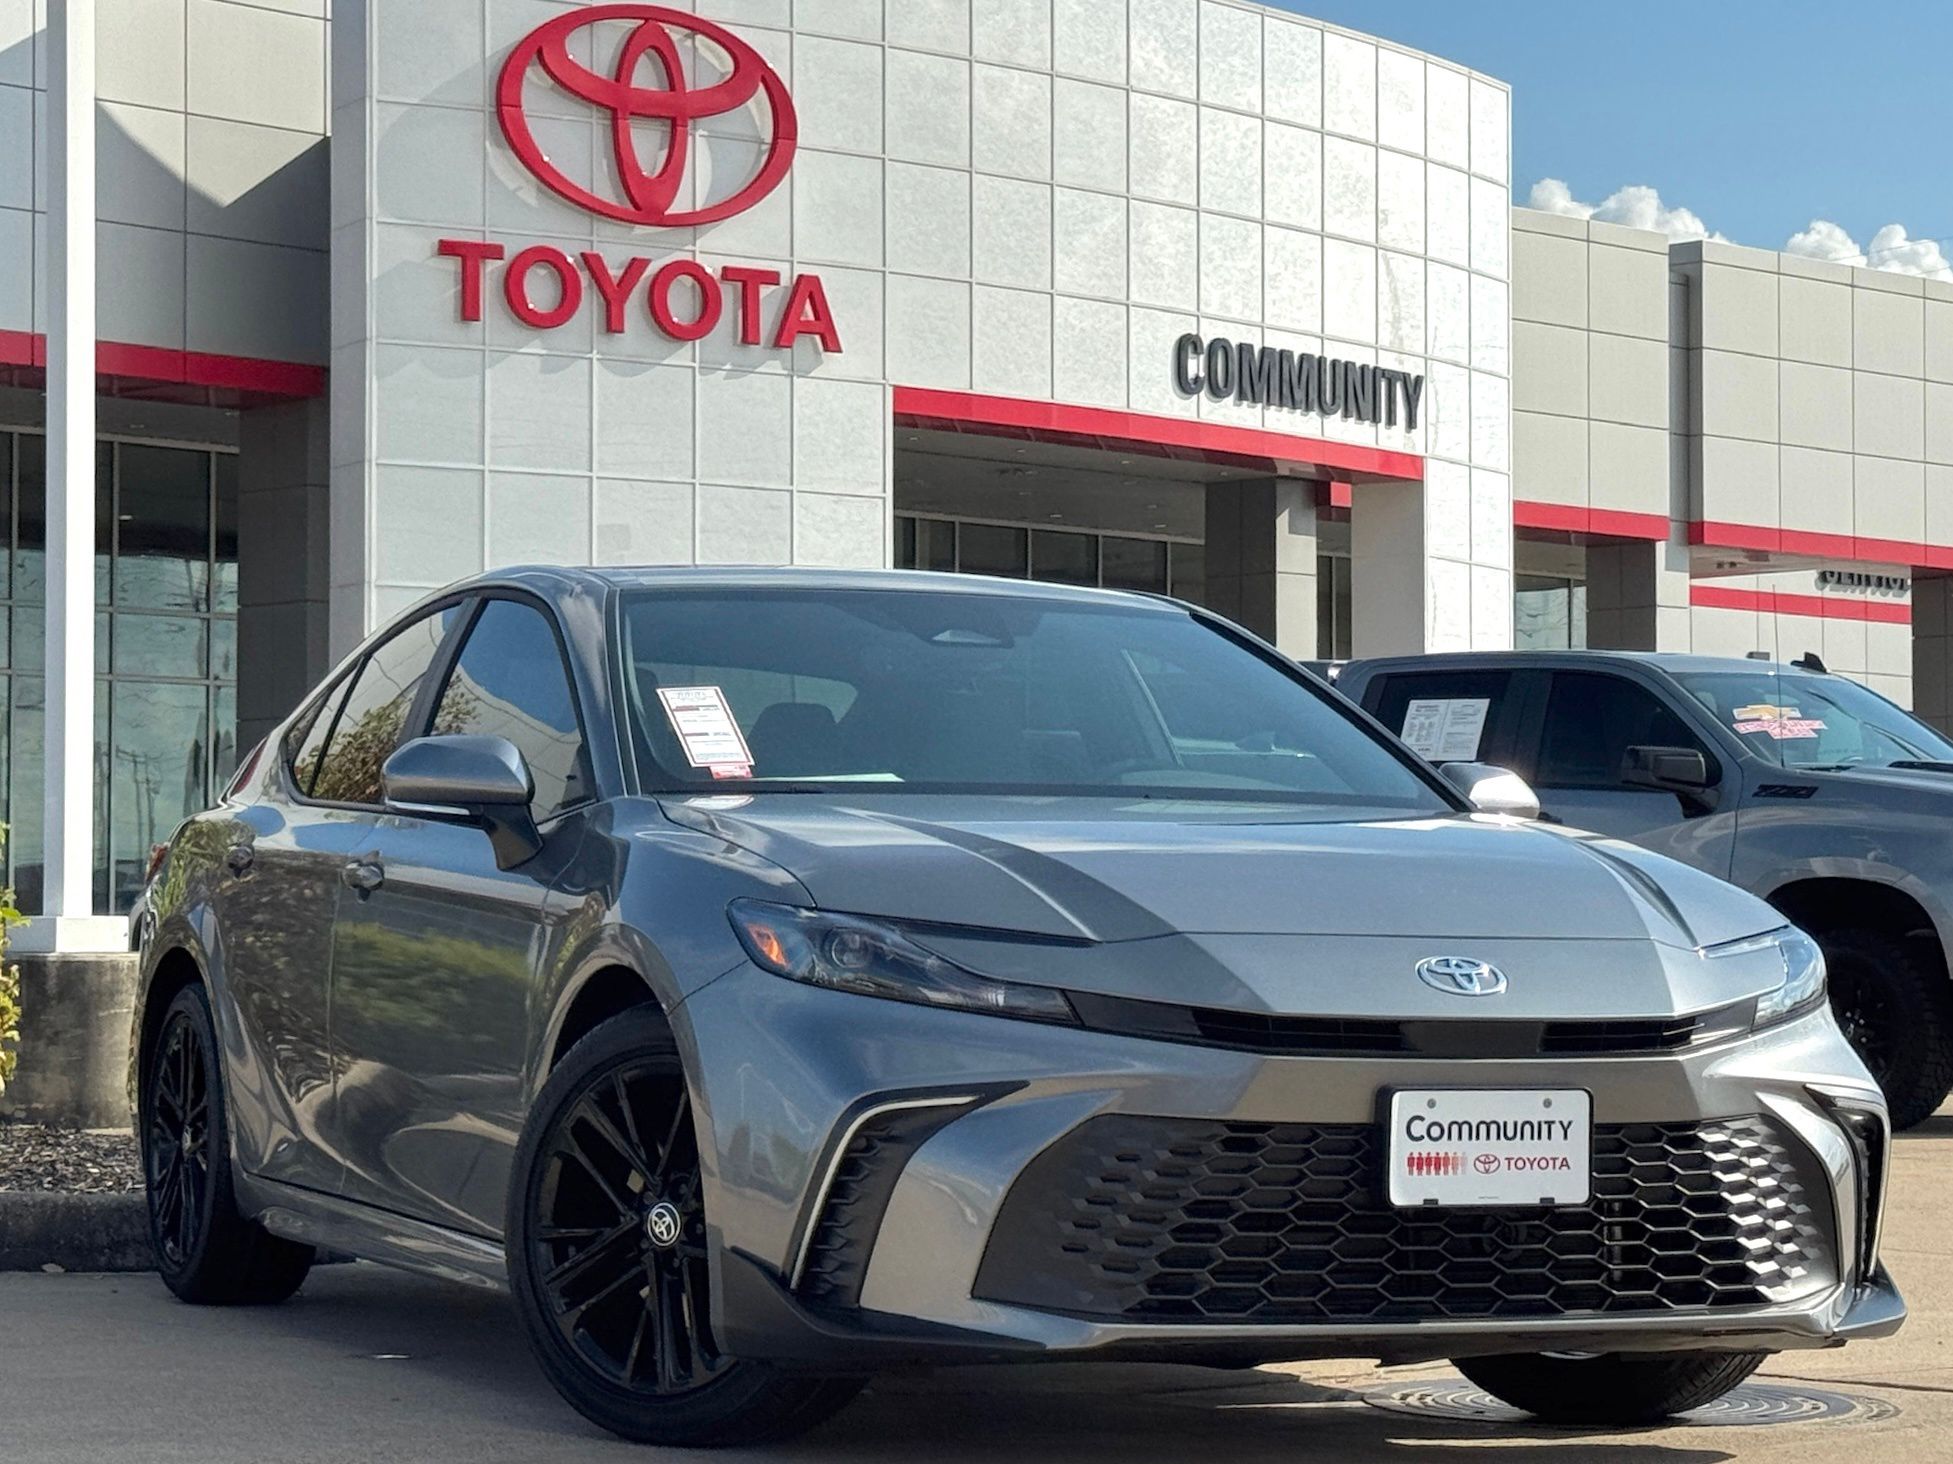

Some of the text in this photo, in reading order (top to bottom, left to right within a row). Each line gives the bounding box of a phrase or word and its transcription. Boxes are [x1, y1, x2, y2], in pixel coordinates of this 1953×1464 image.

[437, 239, 843, 353] TOYOTA
[1174, 333, 1424, 431] COMMUNITY
[1505, 1157, 1571, 1171] TOYOTA
